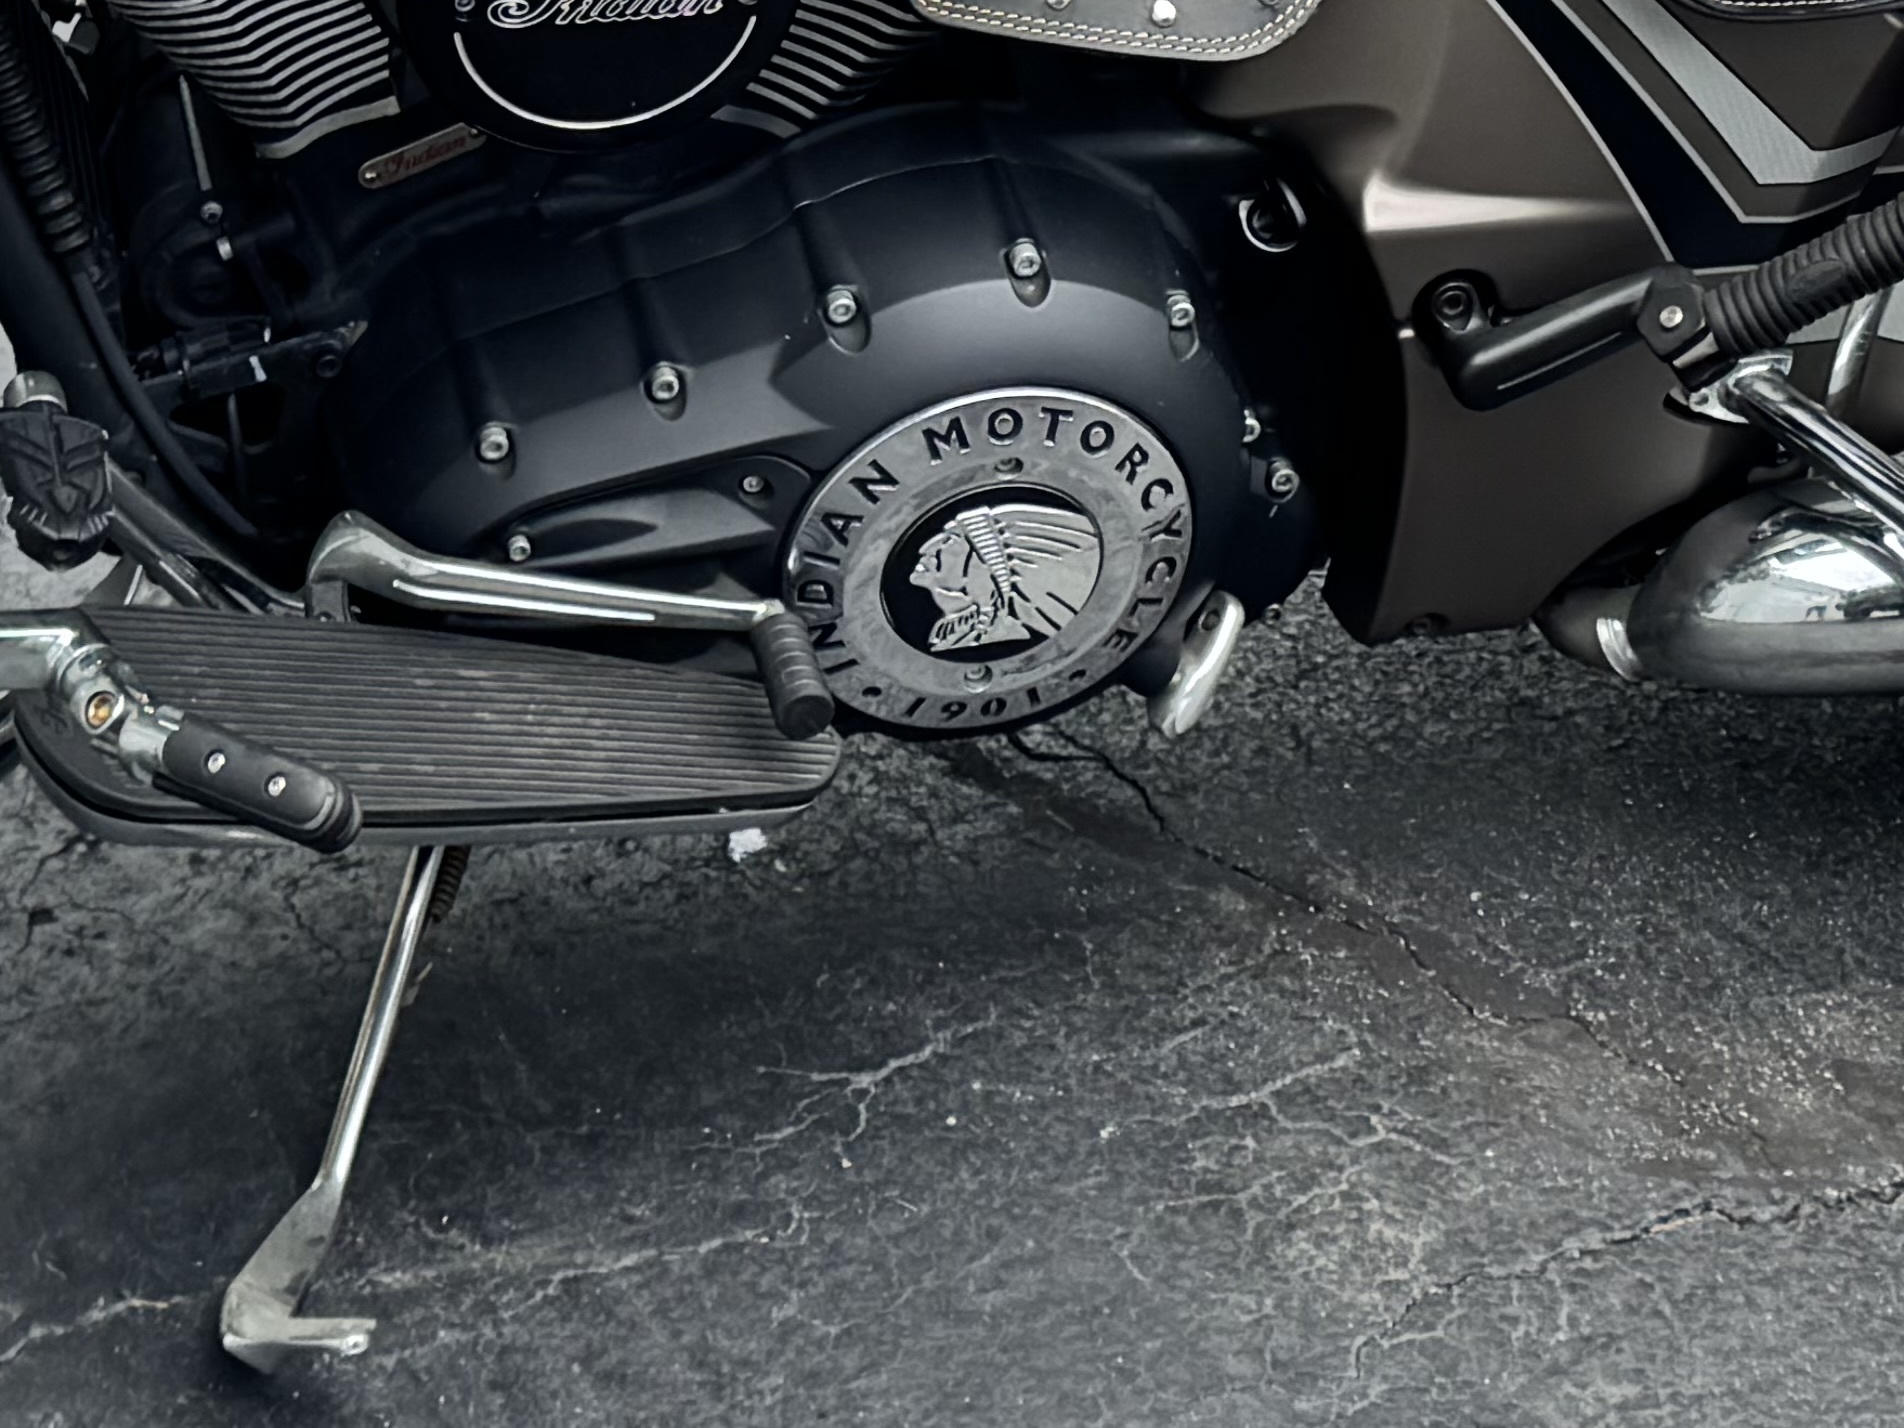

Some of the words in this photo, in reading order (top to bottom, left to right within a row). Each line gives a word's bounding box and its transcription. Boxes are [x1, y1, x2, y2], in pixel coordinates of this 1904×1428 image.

[797, 459, 900, 676] INDIAN
[922, 407, 1187, 653] MOTORCYCLE
[902, 687, 1041, 721] 1901
